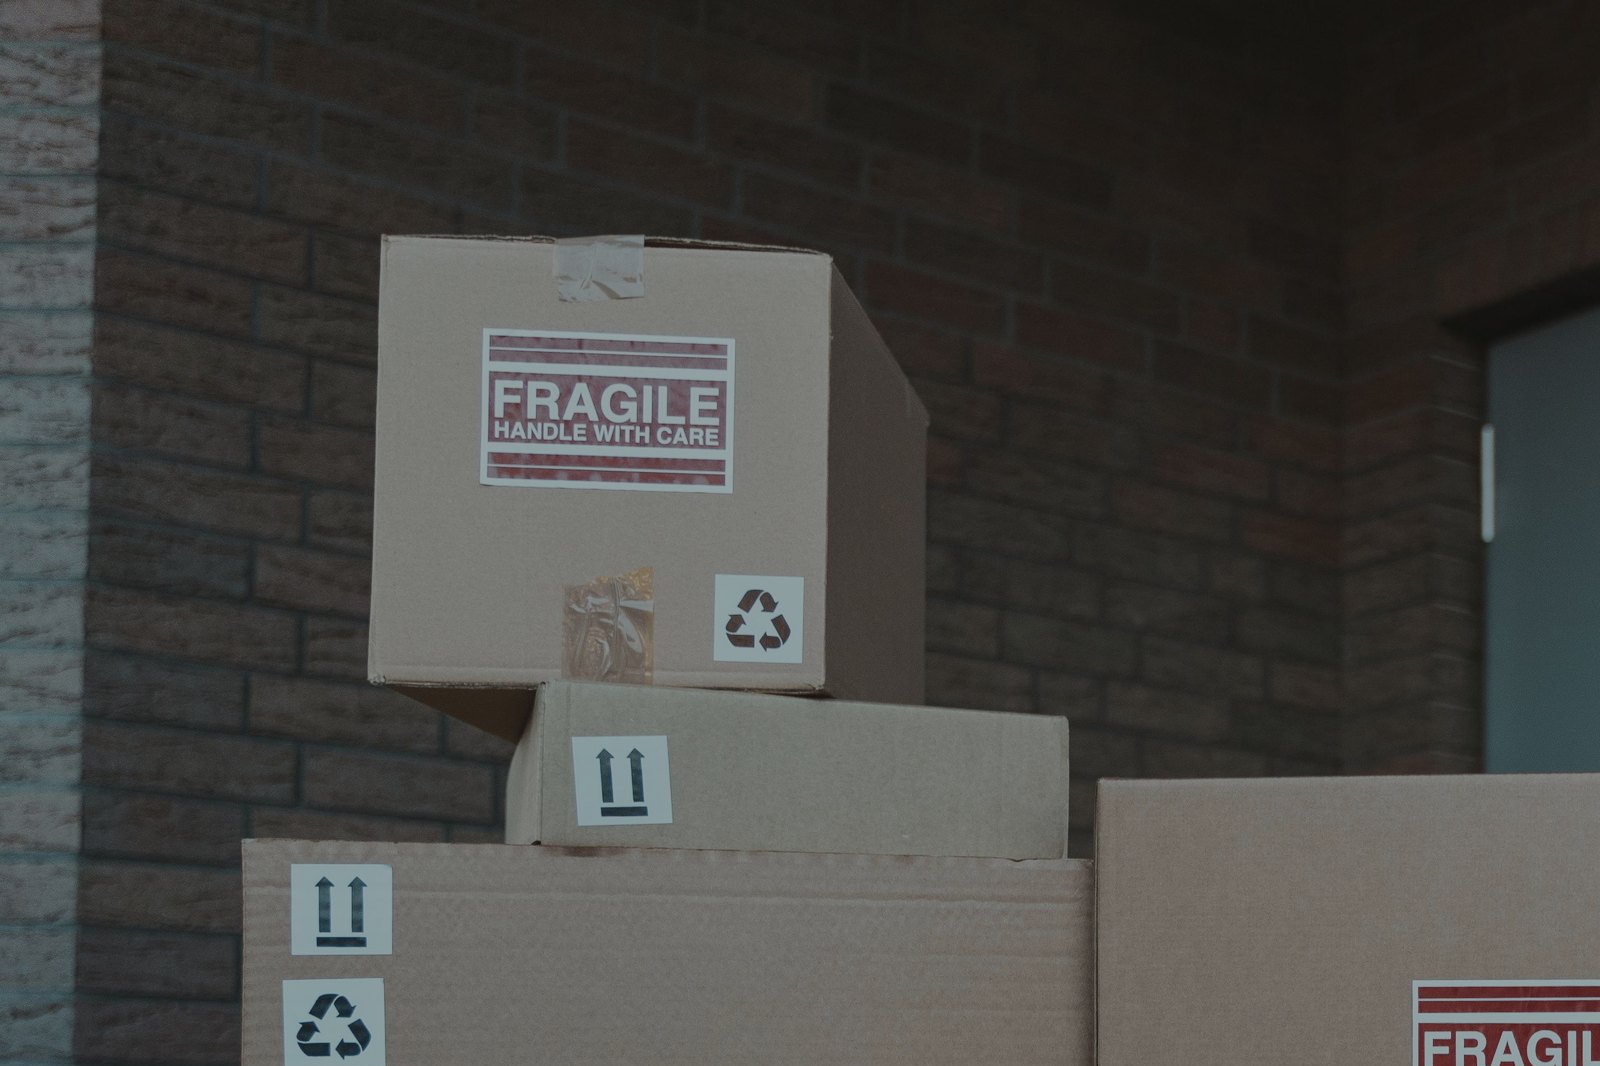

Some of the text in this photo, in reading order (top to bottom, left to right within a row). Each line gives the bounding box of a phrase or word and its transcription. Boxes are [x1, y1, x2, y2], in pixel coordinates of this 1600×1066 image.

[494, 379, 720, 426] FRAGILE
[494, 421, 719, 446] HANDLE WITH CARE
